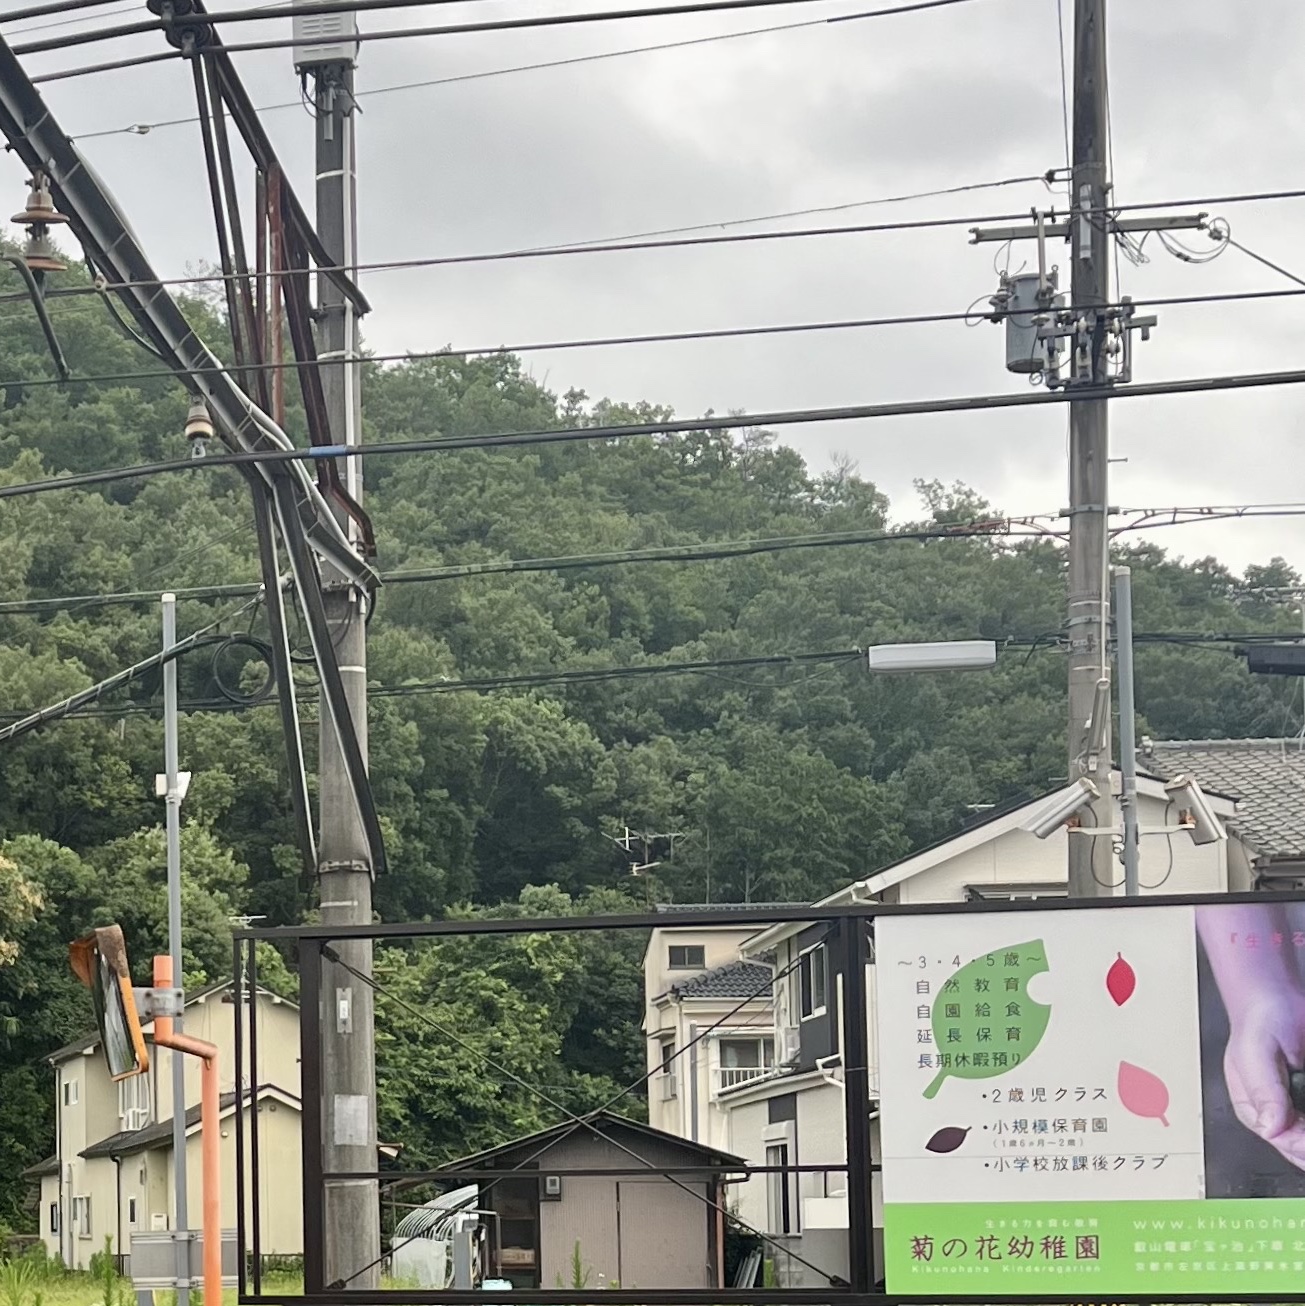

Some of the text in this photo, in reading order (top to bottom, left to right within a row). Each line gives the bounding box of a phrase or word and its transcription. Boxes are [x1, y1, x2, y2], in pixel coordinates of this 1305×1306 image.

[916, 976, 1020, 995] 自然教育
[916, 1001, 1022, 1019] 自園給食
[917, 1026, 1022, 1044] 延長保育
[917, 1051, 1022, 1069] 長期休暇預り
[909, 1233, 1100, 1262] 菊の花幼稚園
